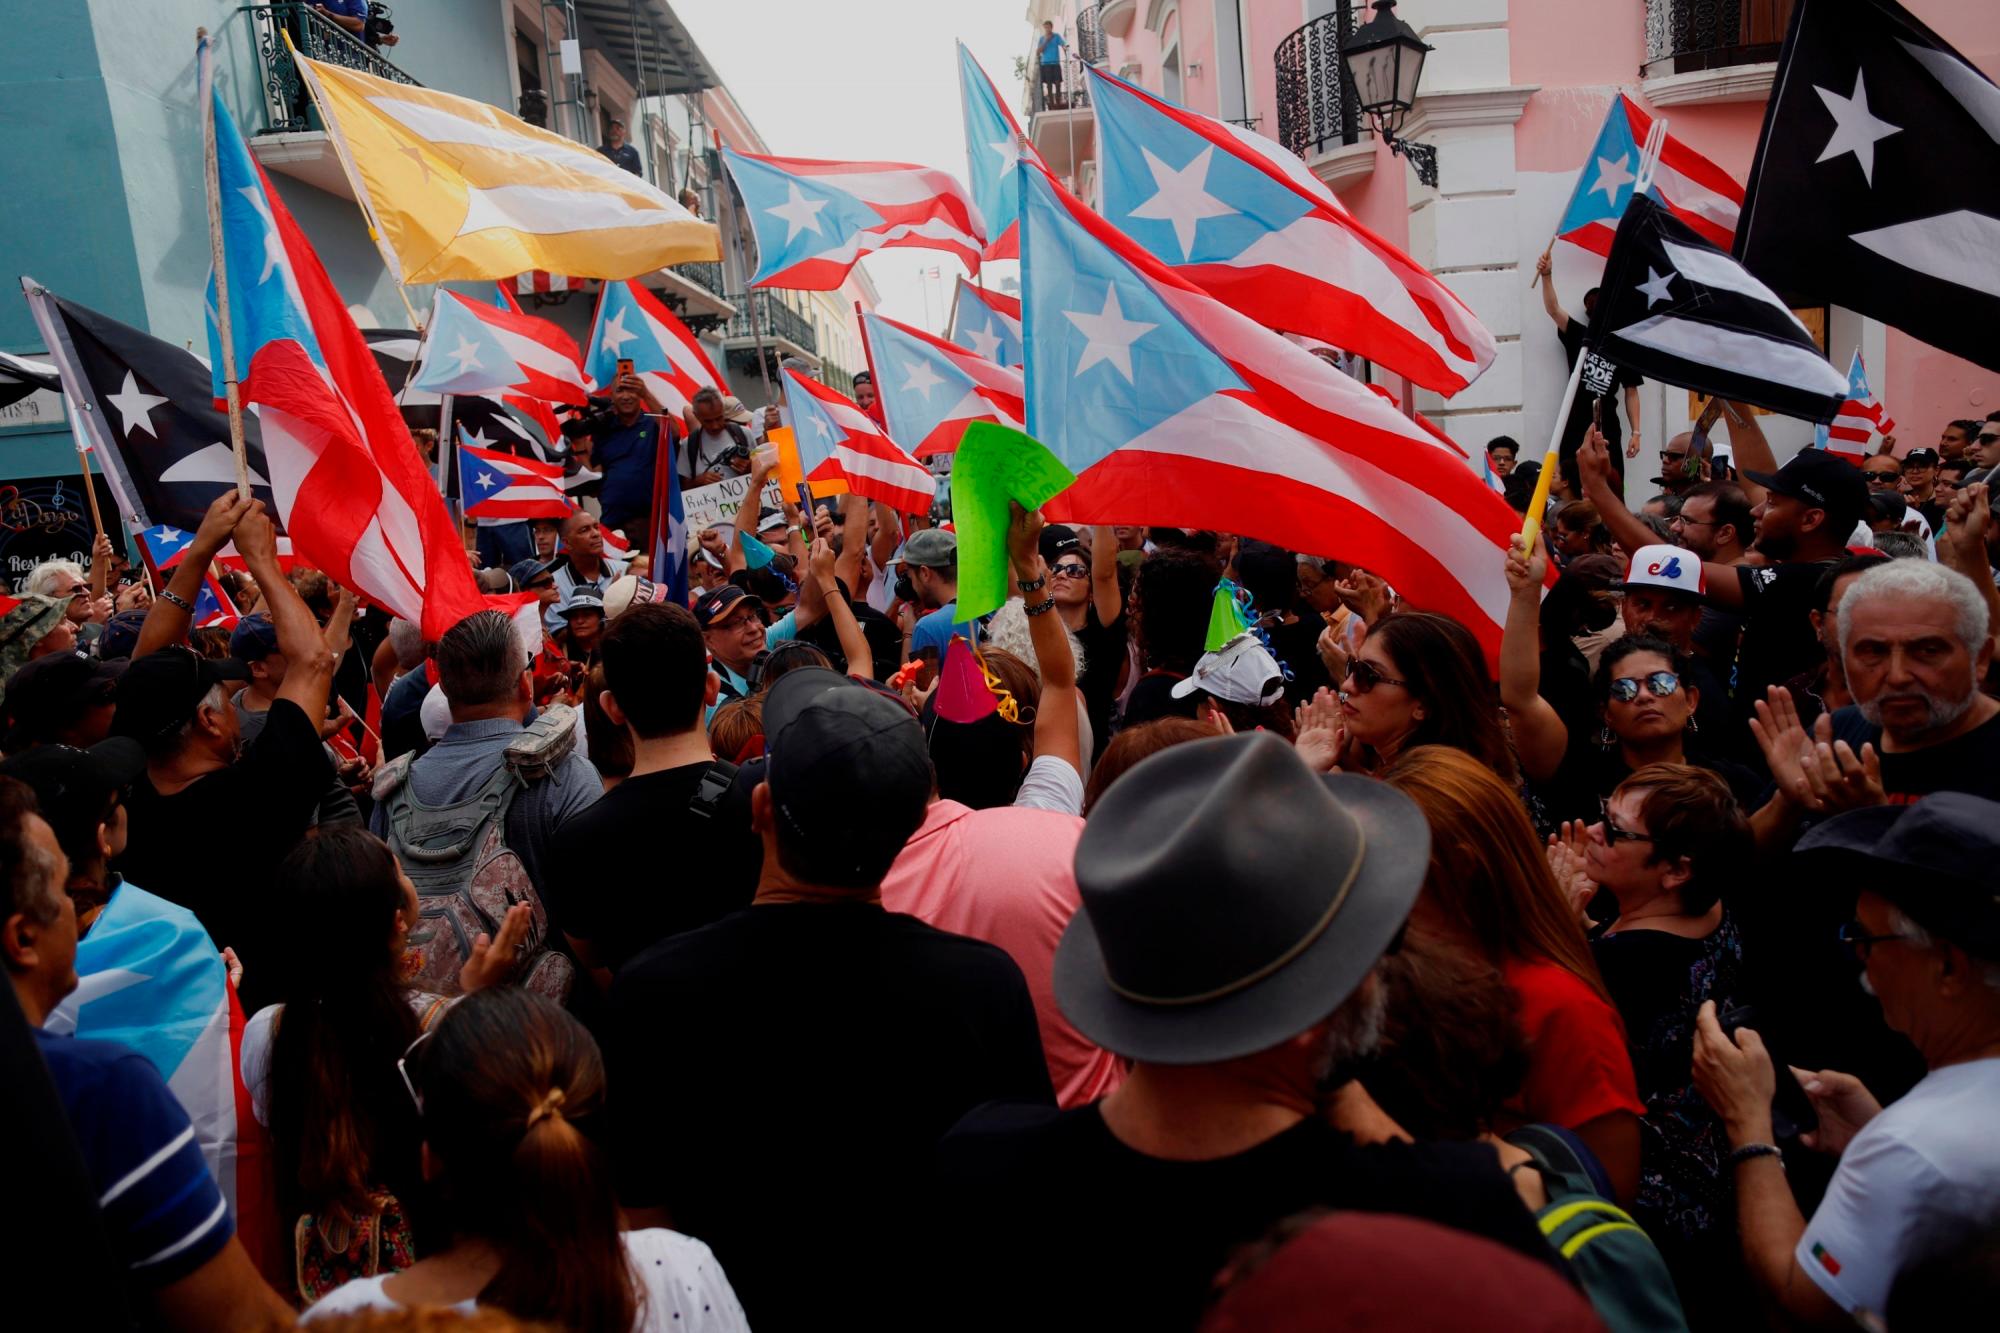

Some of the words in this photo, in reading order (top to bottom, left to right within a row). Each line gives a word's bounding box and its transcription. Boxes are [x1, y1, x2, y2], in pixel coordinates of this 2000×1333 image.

[686, 493, 718, 509] Ricky
[719, 479, 743, 499] NO
[719, 500, 744, 518] PUE
[70, 550, 92, 567] Do
